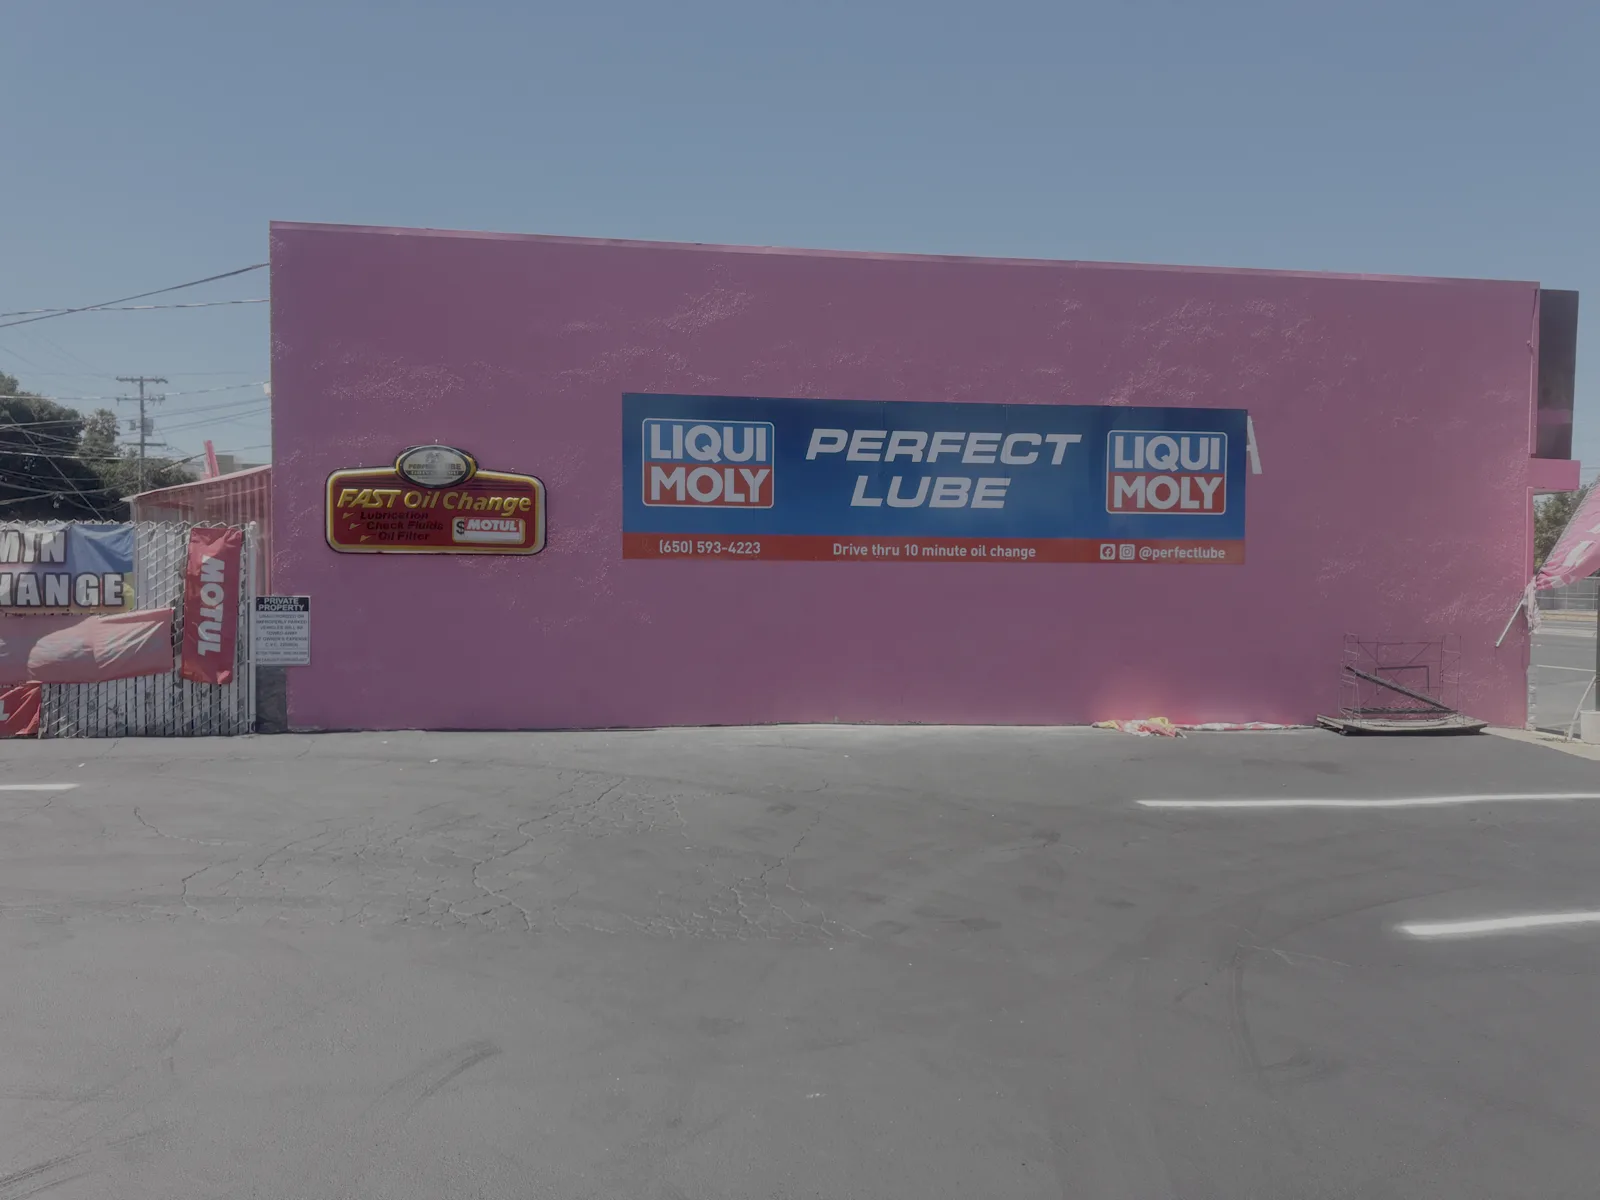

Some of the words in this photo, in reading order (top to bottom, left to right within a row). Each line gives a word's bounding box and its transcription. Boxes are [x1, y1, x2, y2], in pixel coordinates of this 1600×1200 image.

[651, 424, 767, 463] LIQUI
[805, 428, 1082, 465] PERFECT
[1115, 436, 1221, 472] LIQUI
[651, 466, 771, 503] MOLY
[850, 475, 1011, 509] LUBE
[1113, 475, 1223, 510] MOLY
[337, 488, 402, 509] FAST
[403, 490, 441, 509] Oil
[442, 492, 532, 517] Change
[360, 511, 429, 521] Lubrication
[366, 520, 404, 531] Check
[408, 520, 444, 531] Fluids
[378, 531, 395, 541] Oil
[397, 531, 431, 541] Filter
[466, 519, 517, 531] MOTUL
[659, 539, 693, 555] (650)
[696, 540, 761, 555] 593-4223
[833, 543, 868, 557] Drive
[871, 543, 900, 557] thru
[904, 544, 918, 557] 10
[921, 544, 967, 558] minute
[970, 545, 987, 558] oil
[990, 545, 1036, 560] change
[1139, 546, 1226, 561] @perfectlube
[197, 555, 226, 656] MOTUL
